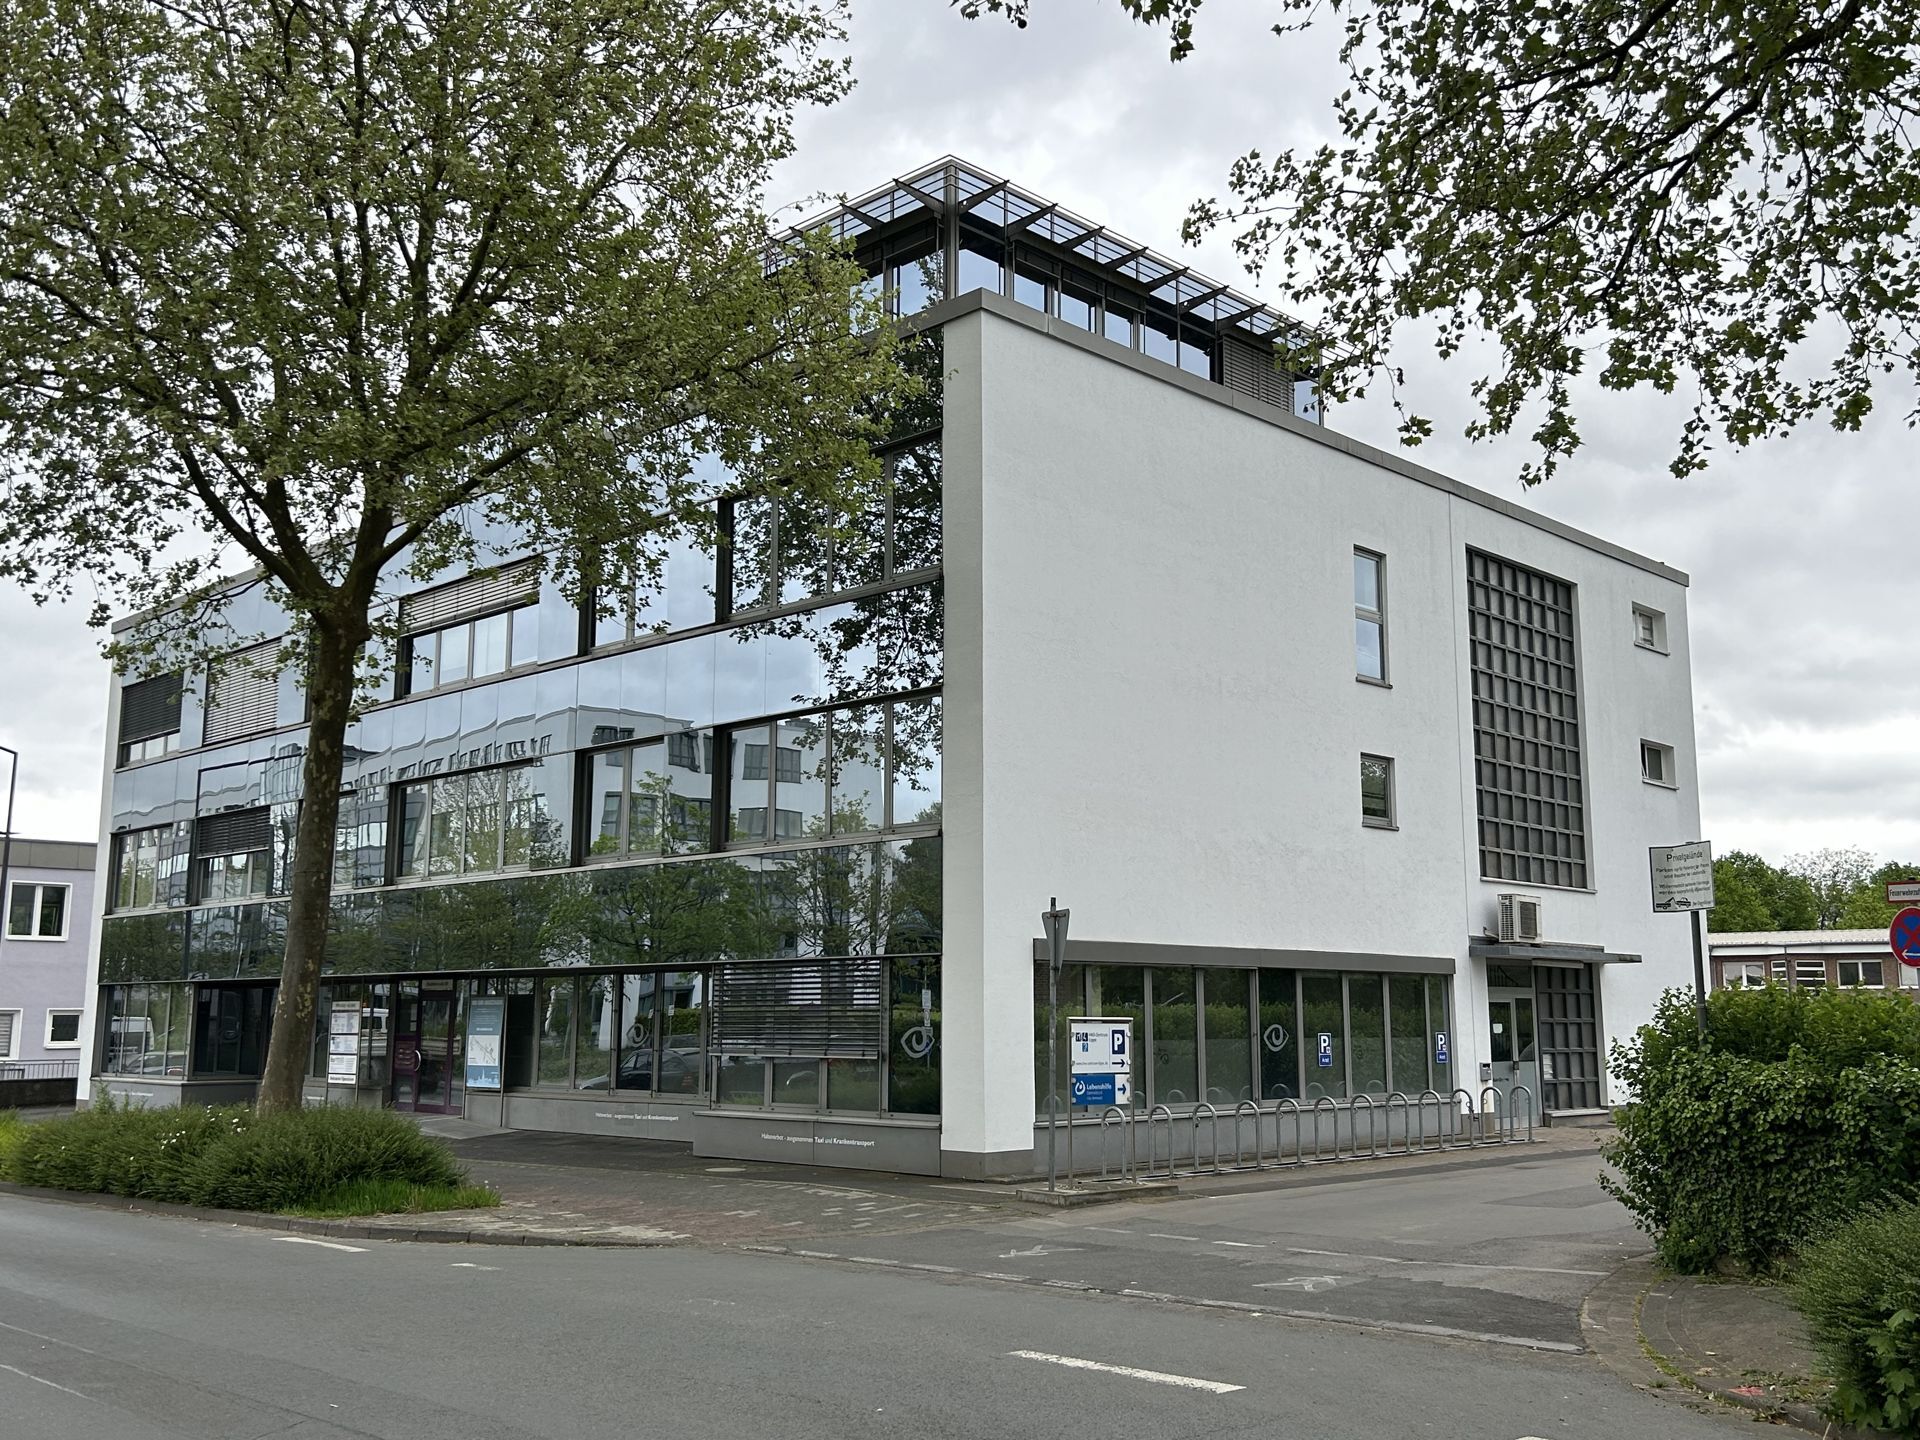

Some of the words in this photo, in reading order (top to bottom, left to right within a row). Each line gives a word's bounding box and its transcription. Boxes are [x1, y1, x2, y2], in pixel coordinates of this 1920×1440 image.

[1113, 1033, 1123, 1051] P
[1320, 1035, 1329, 1053] P
[1437, 1034, 1445, 1051] P
[1086, 1082, 1112, 1090] Lebenshilfe
[833, 1138, 875, 1147] Krankentransport
